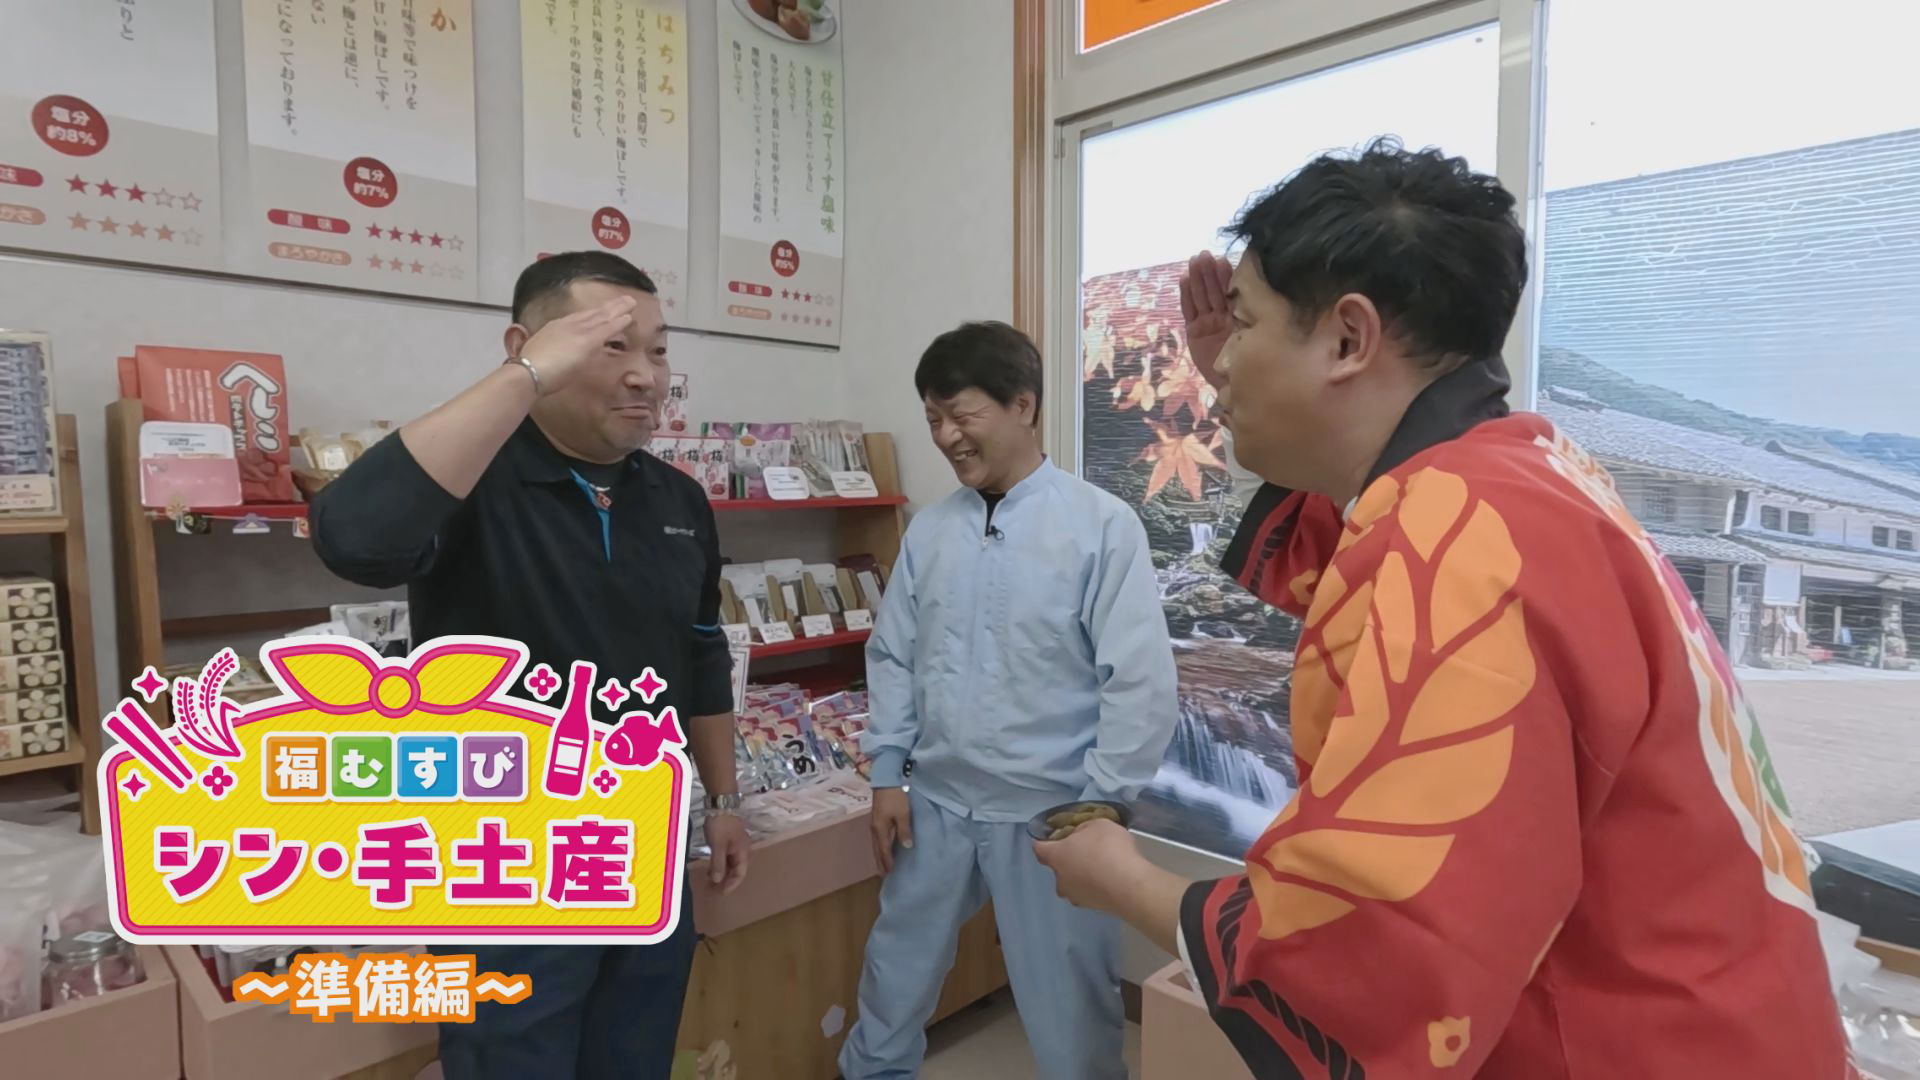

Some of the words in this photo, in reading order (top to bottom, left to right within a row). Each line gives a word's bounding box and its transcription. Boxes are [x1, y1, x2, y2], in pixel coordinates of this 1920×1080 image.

[545, 0, 558, 35] です。
[277, 0, 298, 136] になっております。
[591, 0, 605, 137] 良い塩分で食べやすく、
[635, 8, 649, 148] はちみつを使用し、濃厚で
[656, 14, 676, 124] はちみつ
[51, 105, 91, 126] 塩分
[46, 125, 97, 147] 約8%
[820, 70, 836, 234] 甘仕立てうす塩味
[356, 166, 385, 183] 塩分
[353, 182, 389, 200] 約7%
[601, 214, 622, 228] 塩分
[276, 245, 344, 265] まろやかさ
[776, 246, 794, 259] 塩分
[220, 360, 281, 453] へしこ
[686, 448, 700, 463] 梅
[710, 448, 724, 463] 梅
